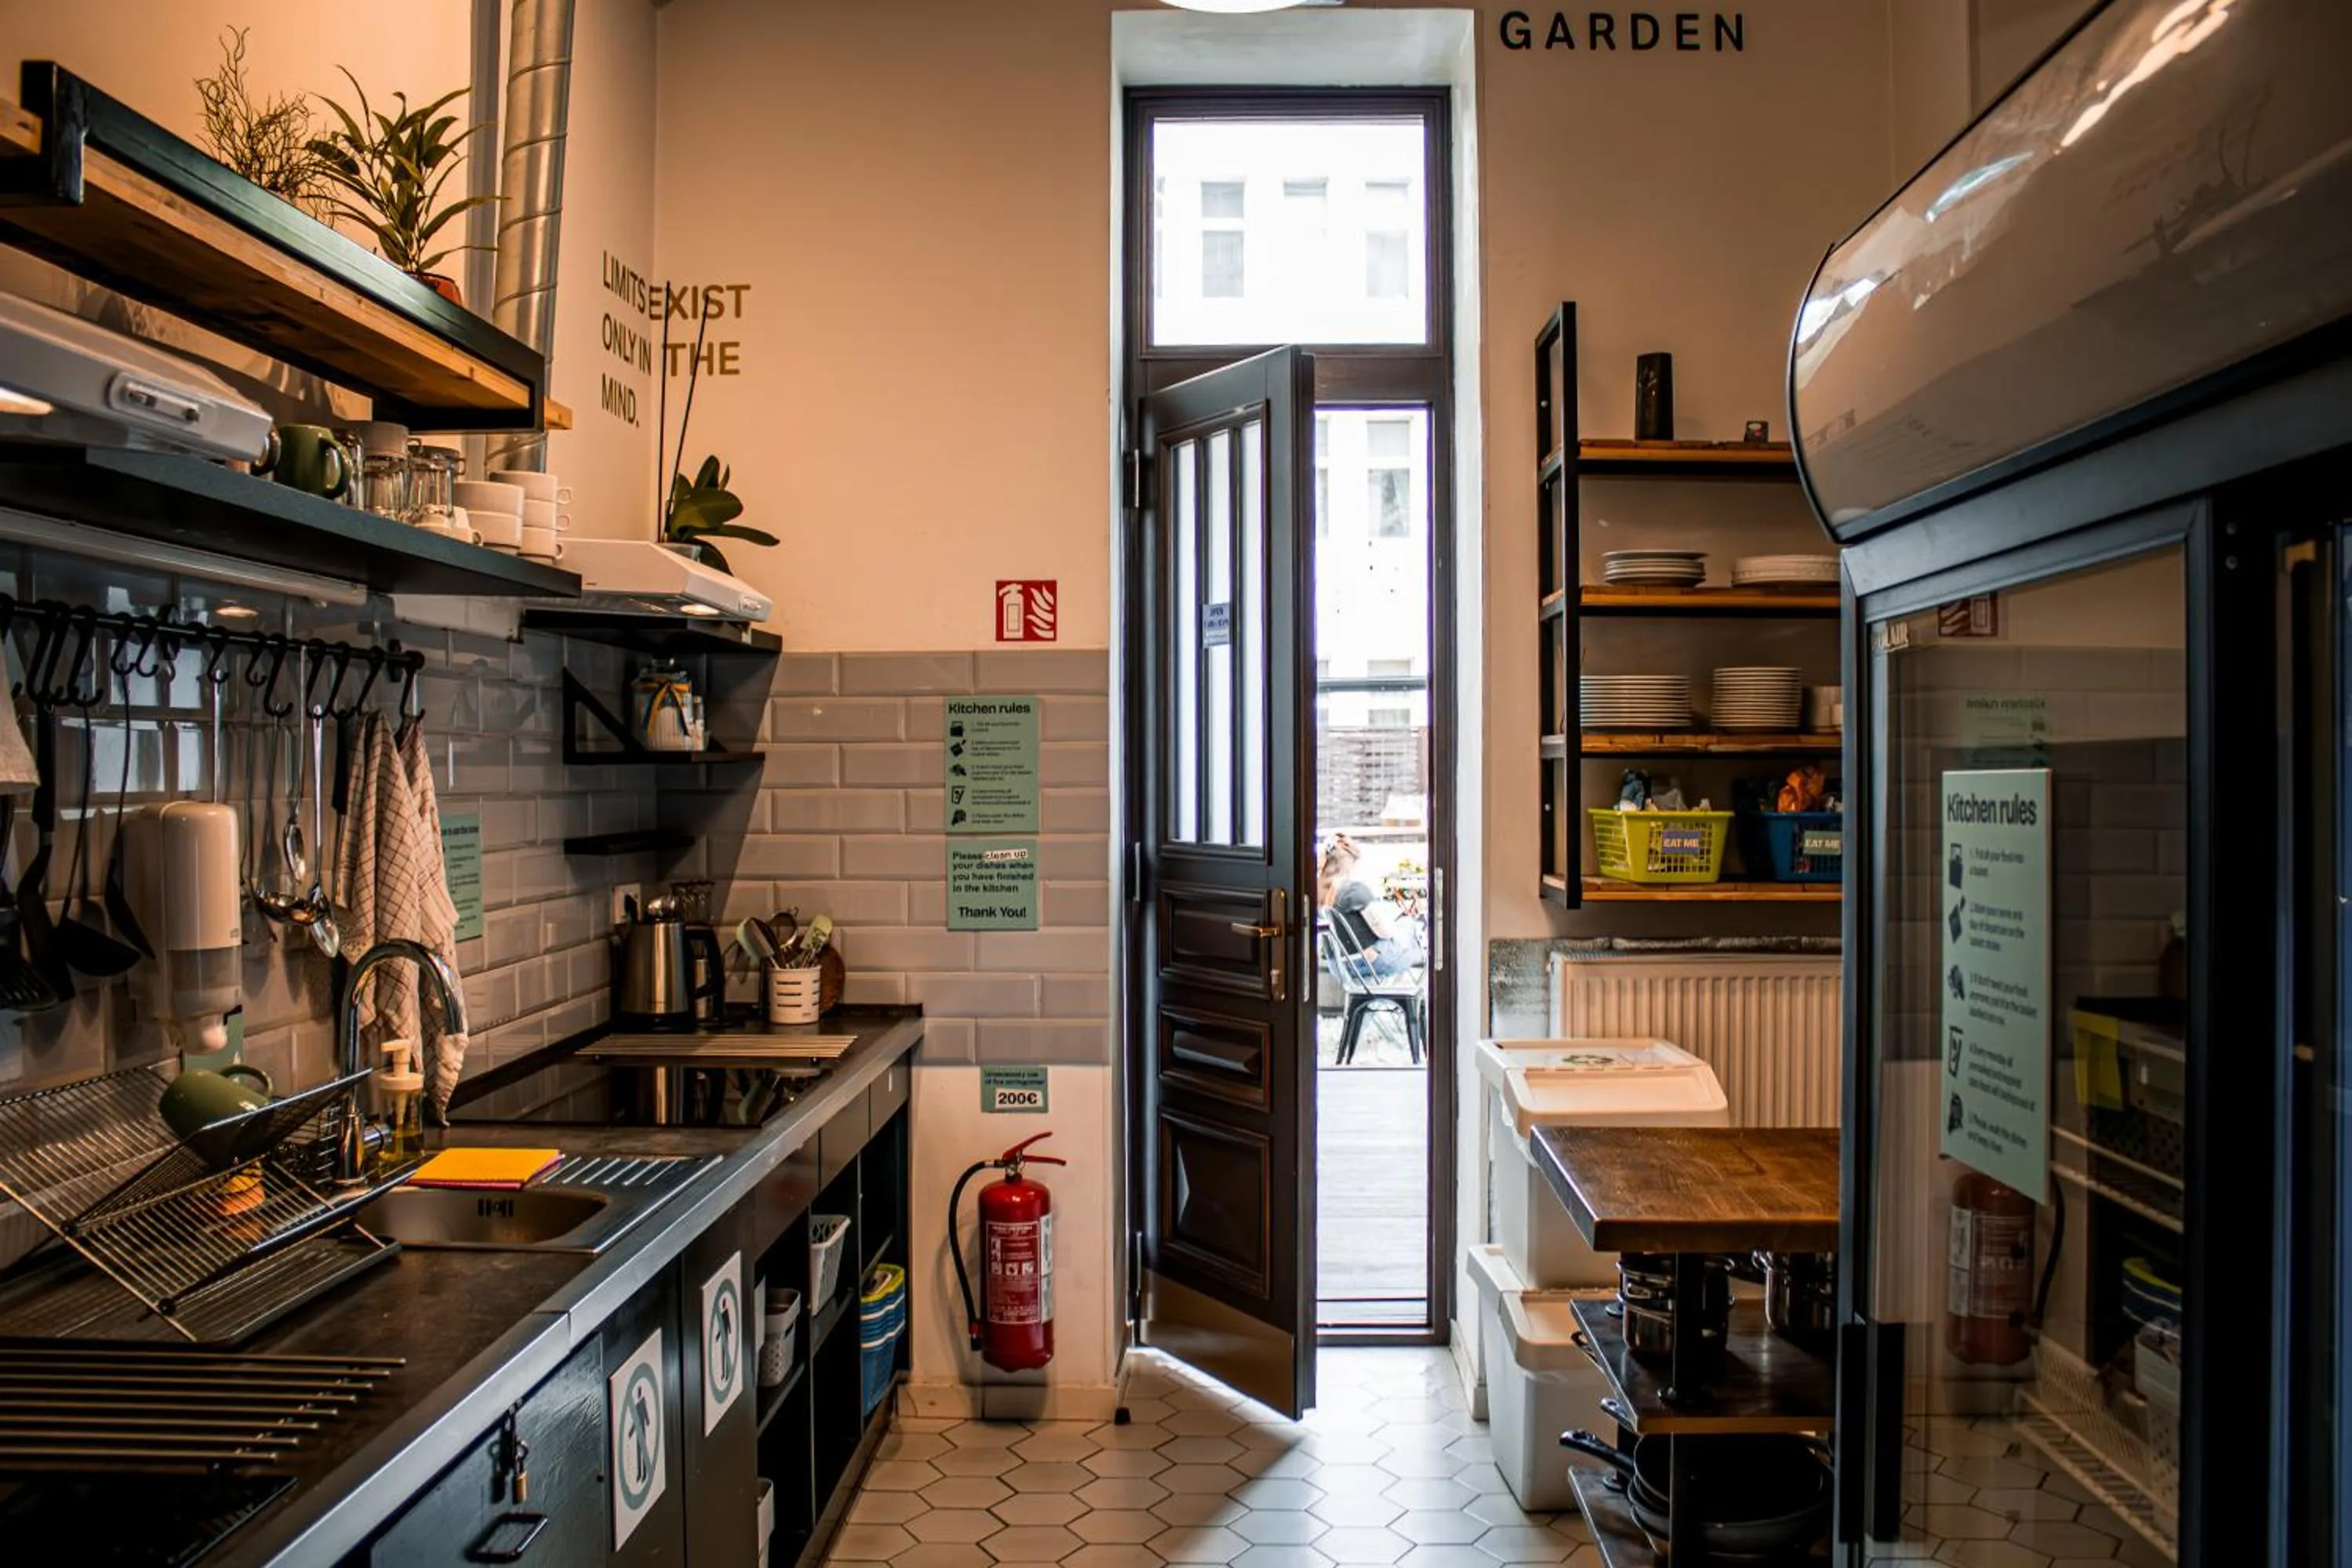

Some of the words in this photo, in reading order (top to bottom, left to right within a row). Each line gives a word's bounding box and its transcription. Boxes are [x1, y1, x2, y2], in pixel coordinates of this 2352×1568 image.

[1499, 11, 1744, 52] GARDEN
[602, 250, 646, 314] LIMITS
[649, 284, 751, 321] EXIST
[602, 313, 637, 366] ONLY
[638, 339, 652, 377] IN
[666, 341, 740, 377] THE
[601, 372, 640, 428] MIND.
[948, 702, 996, 714] Kitchen
[999, 702, 1031, 713] rules
[1947, 793, 1997, 823] Kitchen
[1999, 793, 2037, 826] rules
[1663, 838, 1682, 848] EAT
[1683, 838, 1699, 848] ME
[1806, 839, 1823, 848] EAT
[1824, 840, 1841, 848] ME
[953, 851, 983, 860] Please
[953, 862, 973, 871] your
[972, 872, 993, 880] have
[964, 884, 980, 892] the
[982, 884, 1018, 893] kitchen
[958, 906, 996, 918] Thank
[1000, 906, 1026, 918] You!
[998, 1092, 1038, 1105] 200€
